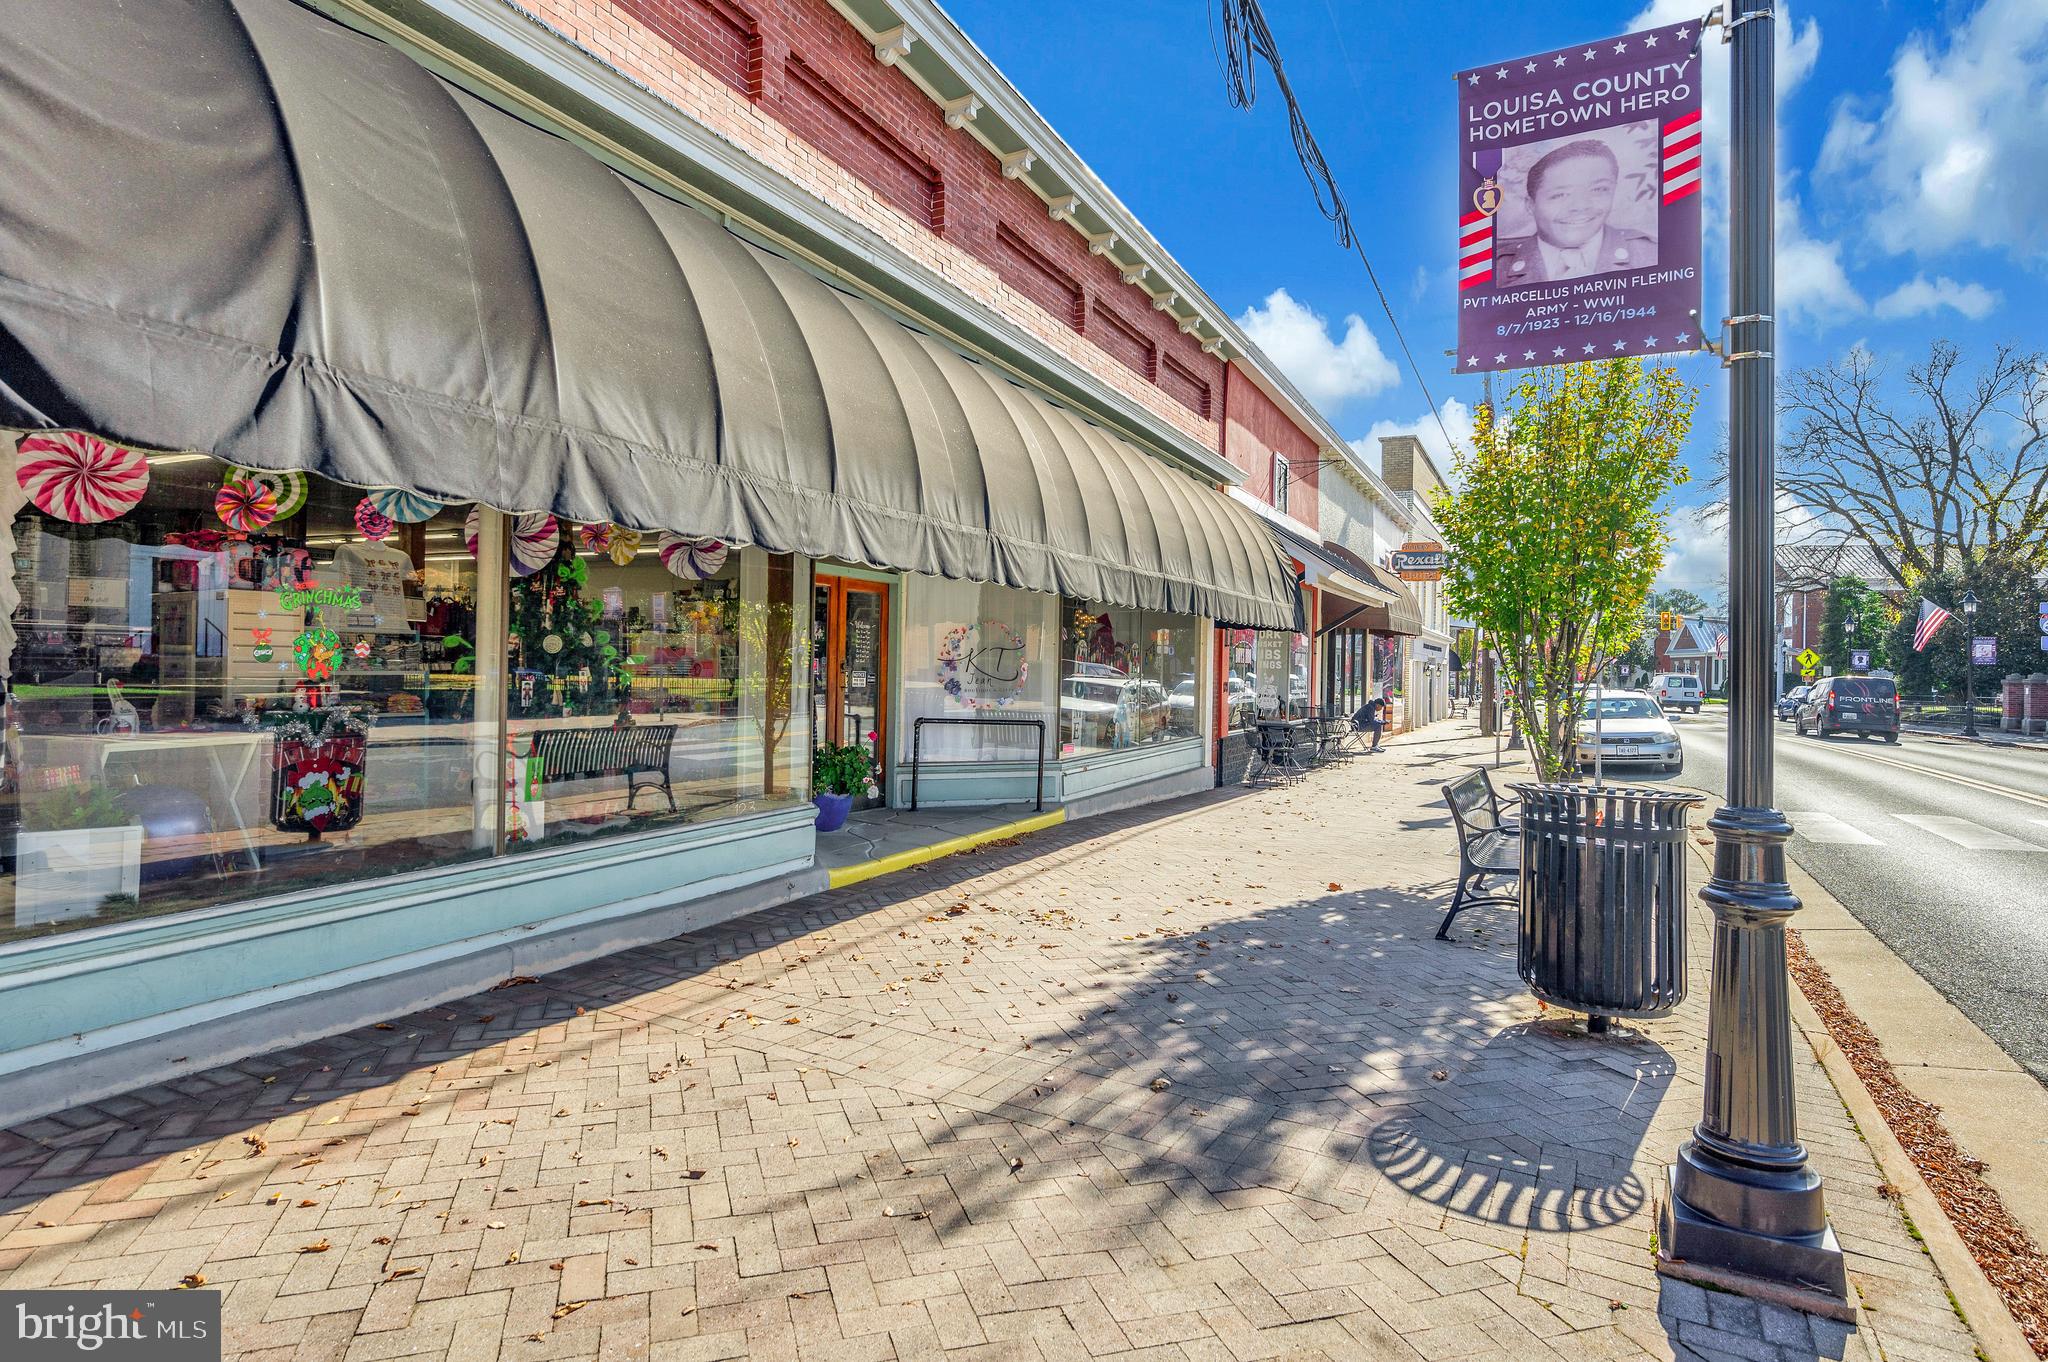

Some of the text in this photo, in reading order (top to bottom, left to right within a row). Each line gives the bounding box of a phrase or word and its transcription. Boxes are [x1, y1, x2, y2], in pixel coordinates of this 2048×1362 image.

[1469, 60, 1690, 122] LOUISA COUNTY
[1469, 83, 1691, 143] HOMETOWN HERO
[1463, 267, 1695, 310] PVT MARCELLUS MARVIN FLEMING
[1496, 317, 1560, 336] 8/7/1923
[1574, 305, 1657, 326] 12/16/1944
[1526, 302, 1569, 318] ARMY
[1584, 295, 1625, 310] WWII
[280, 588, 363, 611] GRINCHMAS
[967, 672, 993, 688] Jean
